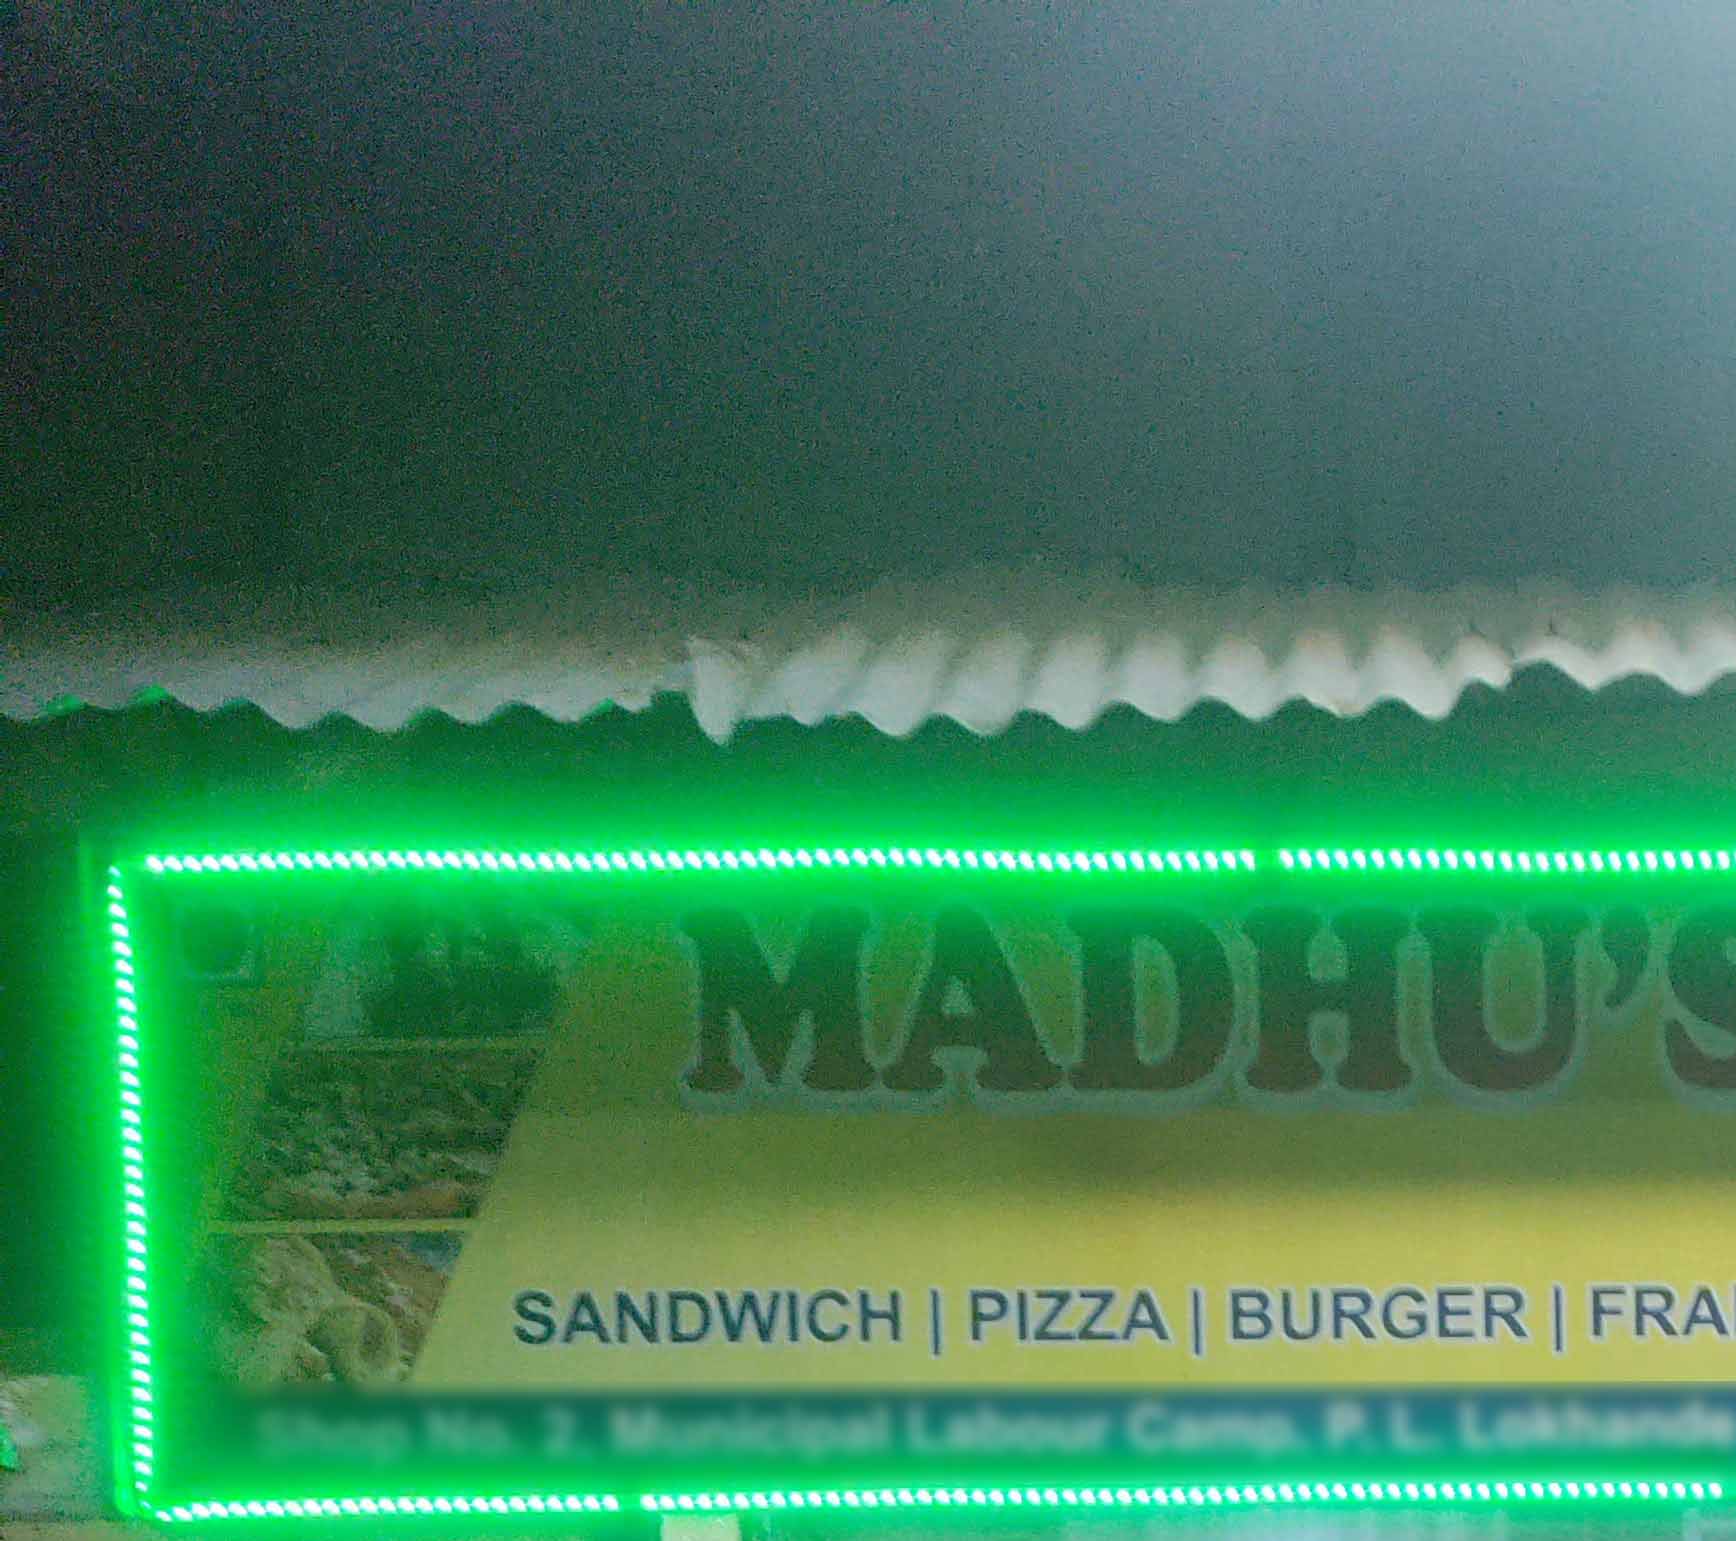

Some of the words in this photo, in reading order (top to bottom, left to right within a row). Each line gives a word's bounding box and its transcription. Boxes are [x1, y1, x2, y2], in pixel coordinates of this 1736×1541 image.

[512, 1288, 902, 1346] SANDWICH
[970, 1287, 1170, 1342] PIZZA
[1230, 1285, 1528, 1342] BURGER
